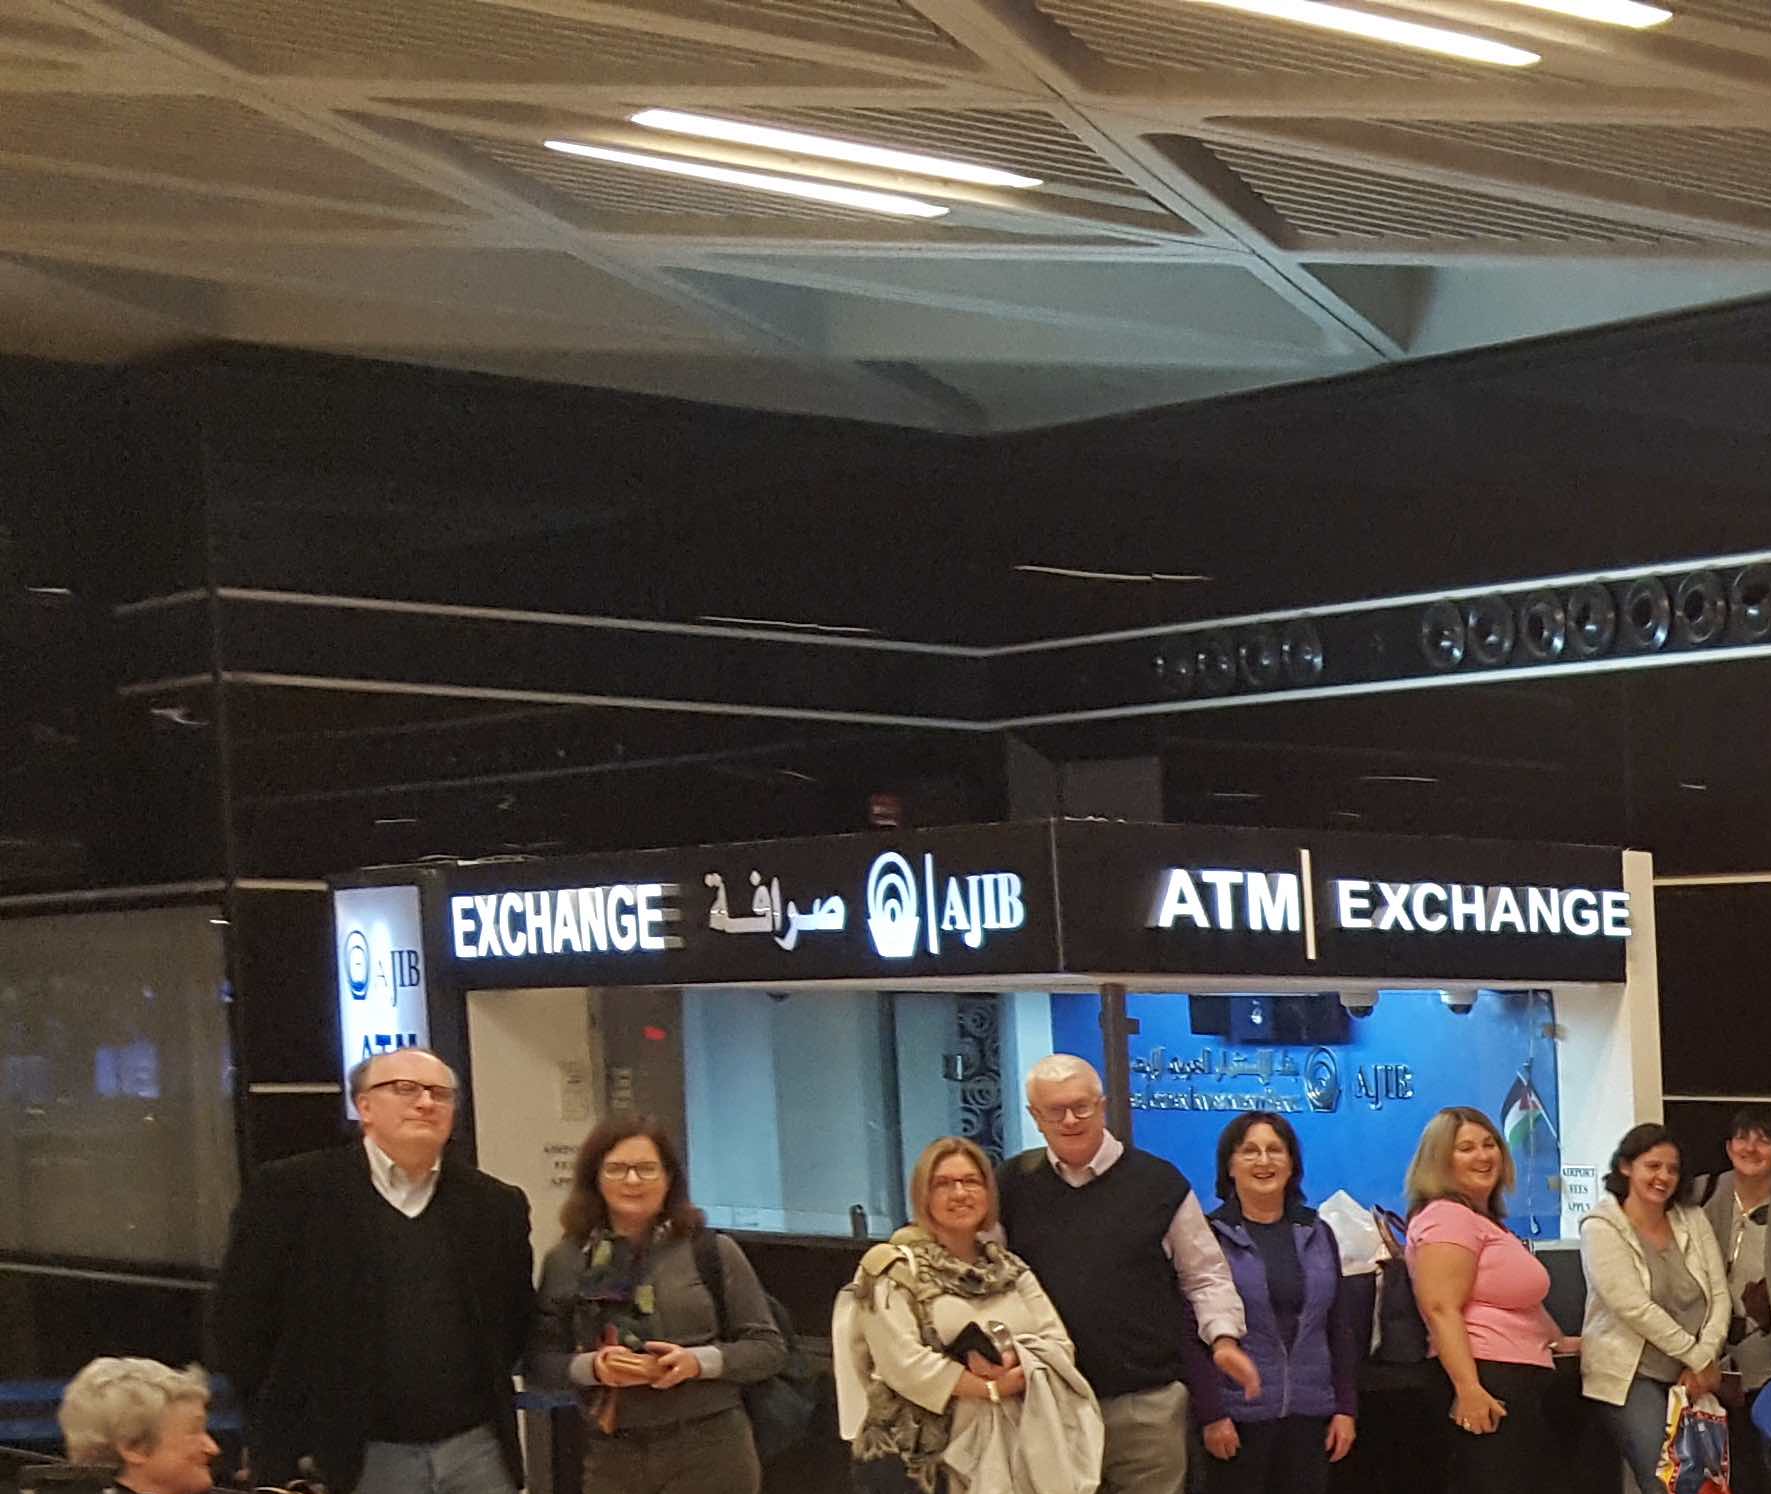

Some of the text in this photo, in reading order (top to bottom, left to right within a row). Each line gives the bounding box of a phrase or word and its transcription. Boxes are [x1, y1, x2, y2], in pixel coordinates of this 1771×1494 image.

[451, 883, 666, 958] EXCHANGE
[704, 870, 846, 951] صرافة
[941, 872, 1025, 949] AJIB
[1157, 868, 1632, 937] ATM EXCHANGE
[374, 949, 421, 1008] AJIB
[1354, 1062, 1415, 1111] AJIB
[1562, 1168, 1595, 1177] AIRPORT
